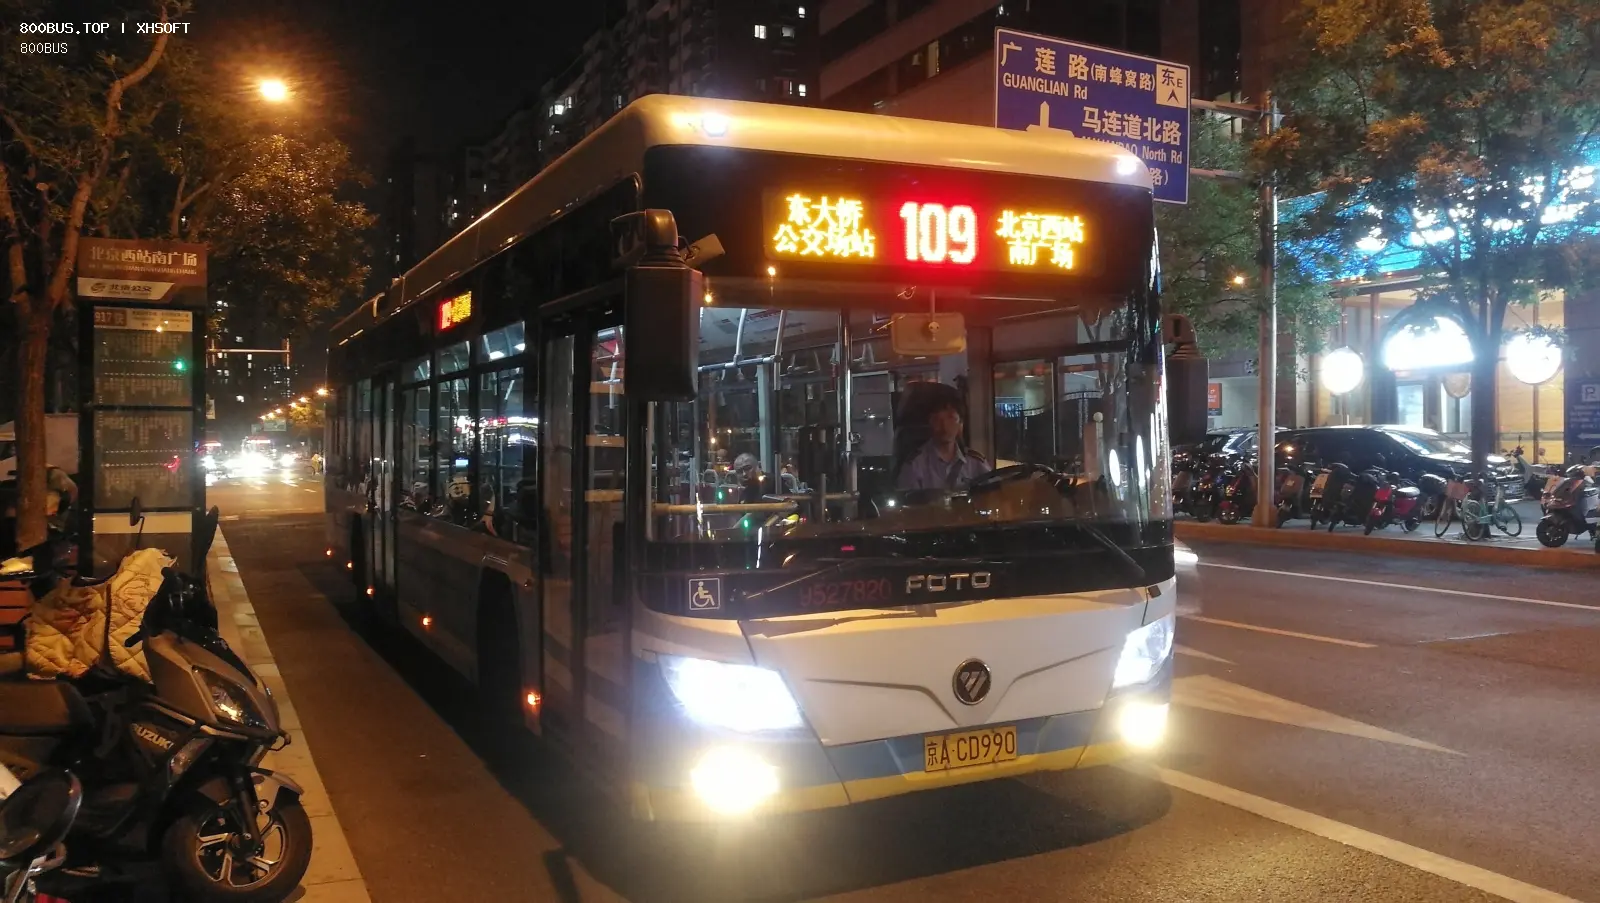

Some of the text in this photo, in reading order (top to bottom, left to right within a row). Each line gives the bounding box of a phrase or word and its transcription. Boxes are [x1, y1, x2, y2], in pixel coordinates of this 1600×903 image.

[1002, 72, 1088, 100] GUANGLIAN Rd
[1161, 68, 1175, 87] 东
[1176, 78, 1183, 88] E
[1082, 106, 1182, 146] 马连道北路
[1141, 145, 1167, 162] North
[1170, 149, 1183, 164] Rd
[786, 193, 863, 227] 东大桥
[773, 224, 876, 257] 公交场站
[899, 201, 978, 264] 109
[996, 210, 1085, 243] 北京西站
[90, 246, 198, 267] 北京西站南广场
[1006, 239, 1074, 270] 南广场
[906, 572, 991, 594] FOTO
